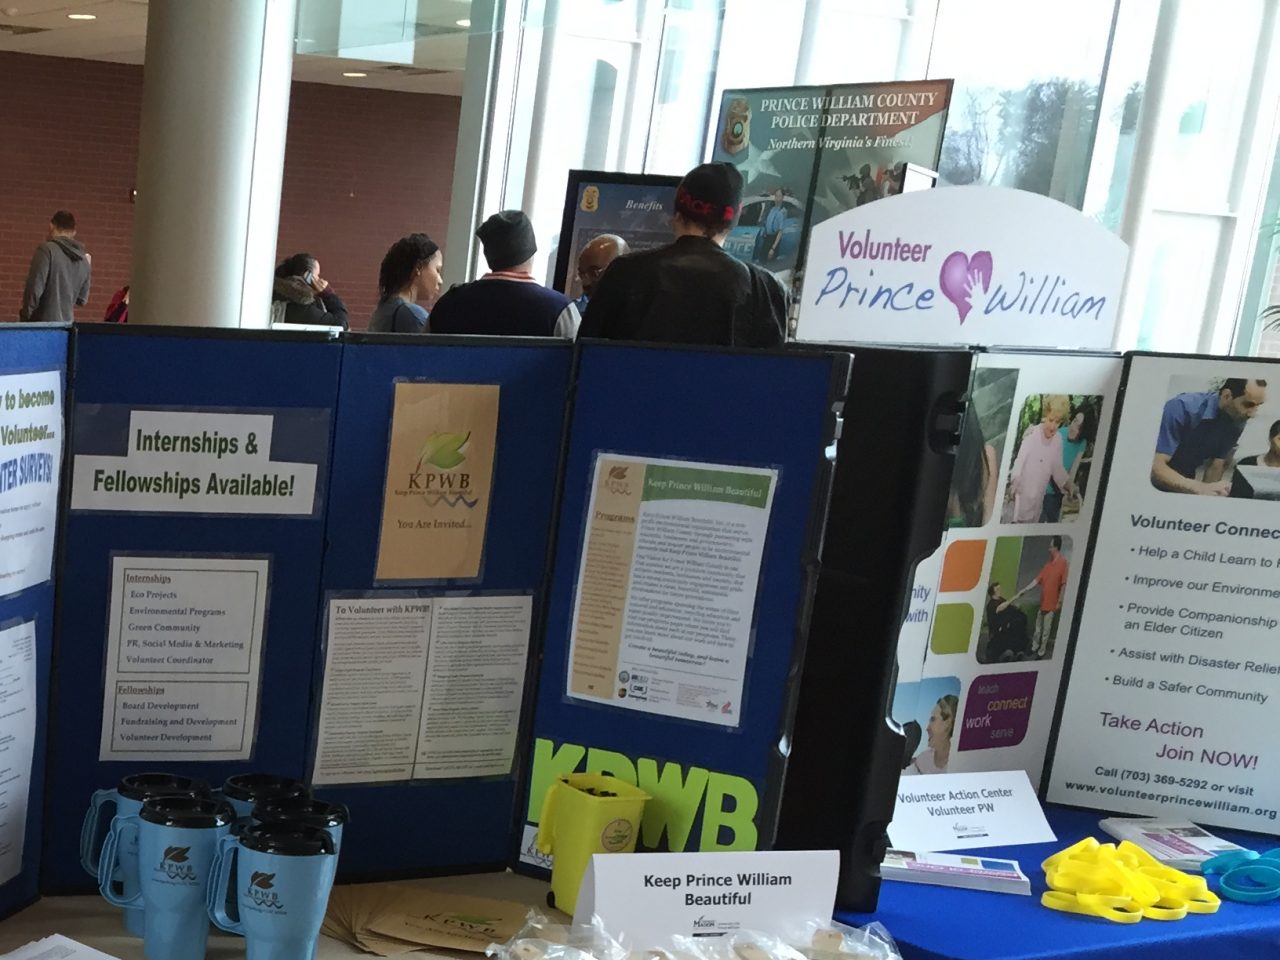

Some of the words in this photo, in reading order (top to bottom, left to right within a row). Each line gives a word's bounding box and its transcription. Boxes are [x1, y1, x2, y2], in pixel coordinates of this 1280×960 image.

[760, 98, 809, 112] PRINCE
[812, 95, 876, 110] WILLIAM
[877, 92, 938, 107] COUNTY
[771, 114, 818, 128] POLICE
[822, 111, 919, 127] DEPARTMENT
[768, 138, 815, 150] Northern
[819, 135, 872, 150] Virginia's
[625, 200, 663, 211] Benefits
[838, 229, 932, 262] Volunteer
[815, 266, 935, 311] Prince
[984, 272, 1106, 320] William
[5, 390, 16, 411] to
[19, 389, 55, 409] become
[136, 429, 239, 459] Internships
[245, 432, 258, 455] &
[93, 469, 201, 499] Fellowships
[206, 472, 295, 496] Available!
[409, 473, 470, 489] KPWB
[648, 478, 667, 488] Keep
[669, 480, 692, 491] Prince
[694, 482, 724, 494] William
[725, 486, 762, 498] Beautiful
[397, 519, 413, 528] You
[416, 519, 431, 528] Are
[595, 510, 635, 523] Programs
[1131, 514, 1210, 533] Volunteer
[1138, 546, 1168, 560] Help
[1171, 550, 1179, 559] a
[1183, 550, 1216, 563] Child
[1220, 553, 1256, 567] Learn
[1261, 556, 1273, 568] to
[126, 574, 171, 584] Internships
[1133, 575, 1184, 589] Improve
[1187, 582, 1209, 591] our
[130, 590, 145, 598] Eco
[146, 590, 177, 600] Projects
[129, 607, 187, 616] Environmental
[189, 608, 225, 617] Programs
[335, 605, 346, 614] To
[348, 605, 384, 614] Volunteer
[386, 605, 403, 614] with
[906, 609, 928, 623] with
[1127, 603, 1174, 617] Provide
[1178, 608, 1277, 629] Companionship
[154, 624, 200, 633] Community
[1124, 621, 1139, 630] an
[1144, 621, 1176, 634] Elder
[1180, 625, 1223, 639] Citizen
[126, 640, 141, 648] PR,
[142, 640, 166, 648] Social
[168, 640, 192, 648] Media
[194, 640, 202, 648] &
[204, 640, 244, 649] Marketing
[126, 656, 164, 664] Volunteer
[166, 656, 213, 664] Coordinator
[1118, 648, 1156, 661] Assist
[1160, 653, 1185, 664] with
[1189, 655, 1240, 671] Disaster
[118, 685, 164, 695] Fellowships
[1112, 675, 1144, 688] Build
[1147, 681, 1155, 689] a
[1158, 680, 1192, 694] Safer
[1196, 685, 1269, 704] Community
[122, 702, 145, 710] Board
[147, 702, 199, 711] Development
[988, 696, 1028, 711] connect
[121, 718, 168, 726] Fundraising
[186, 718, 237, 727] Development
[966, 714, 992, 729] work
[1100, 712, 1141, 731] Take
[1145, 719, 1204, 739] Action
[160, 734, 212, 743] Development
[1155, 744, 1194, 762] Join
[1201, 749, 1259, 770] NOW!
[1095, 766, 1118, 778] Call
[1121, 768, 1150, 784] (703)
[1153, 774, 1208, 790] 369-5292
[1211, 783, 1224, 792] or
[1228, 784, 1254, 796] visit
[898, 792, 946, 803] Volunteer
[949, 789, 979, 801] Action
[982, 788, 1012, 798] Center
[1065, 781, 1277, 820] www.volunteerprincewilliam.org
[927, 806, 975, 817] Volunteer
[978, 803, 995, 813] PW
[644, 875, 681, 890] Keep
[686, 873, 733, 887] Prince
[737, 873, 792, 886] William
[685, 892, 752, 906] Beautiful
